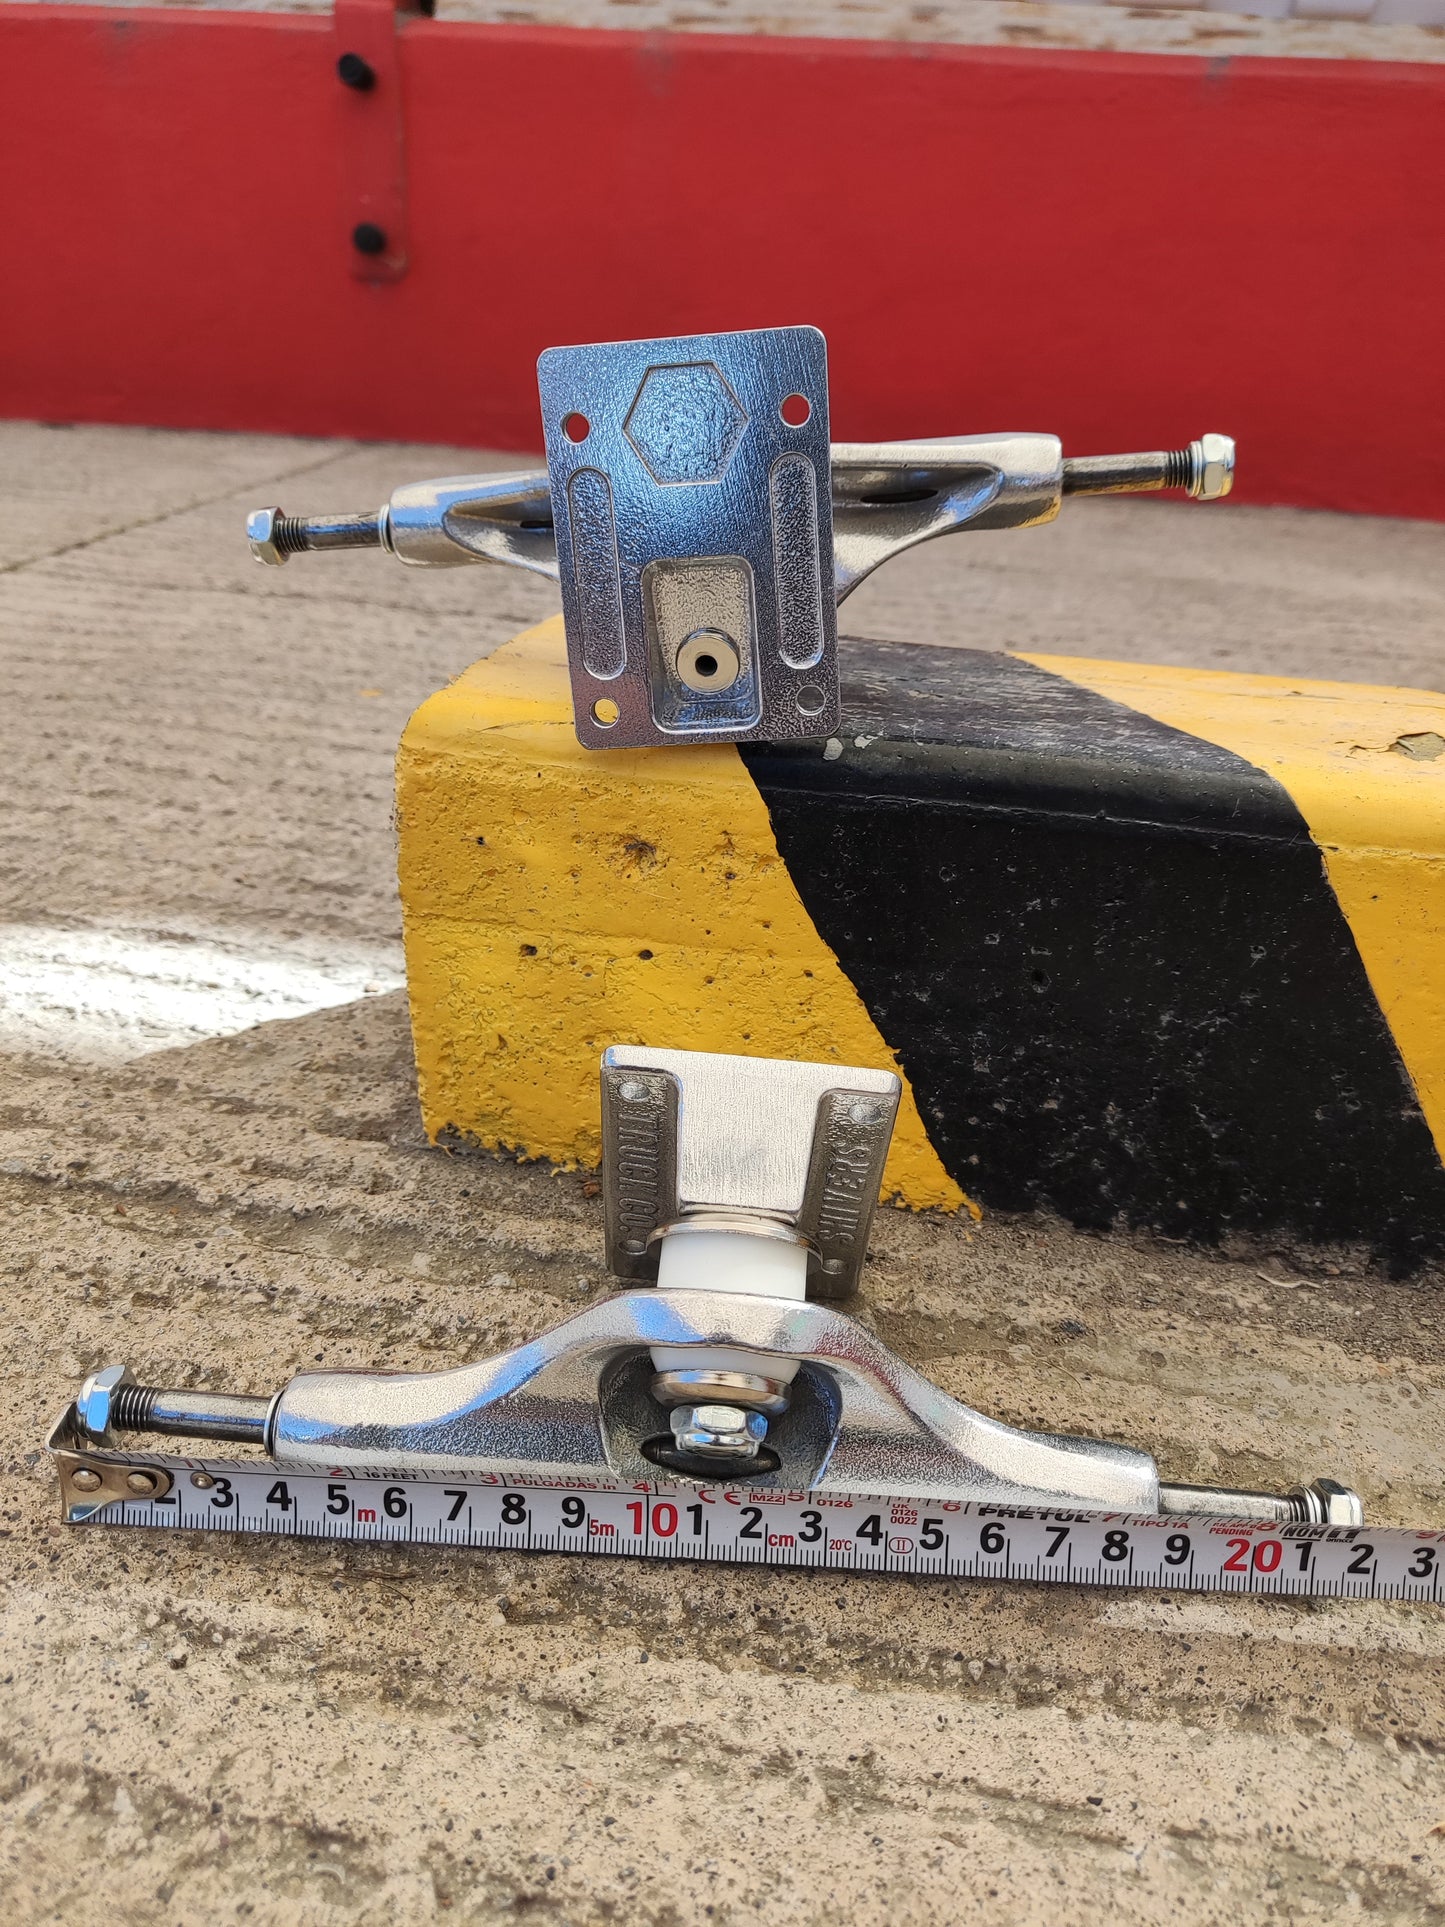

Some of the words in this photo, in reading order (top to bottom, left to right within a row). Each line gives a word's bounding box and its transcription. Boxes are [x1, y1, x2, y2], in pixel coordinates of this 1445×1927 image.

[363, 1471, 380, 1479] 16
[383, 1472, 419, 1480] FEET
[480, 1472, 499, 1484] 3
[512, 1478, 597, 1489] PULGADAS
[632, 1480, 651, 1492] 4
[752, 1494, 783, 1503] M22
[787, 1492, 805, 1502] 5
[816, 1499, 853, 1508] 0126
[942, 1502, 961, 1512] 6
[357, 1508, 376, 1523] m
[891, 1508, 918, 1517] 0126
[890, 1516, 918, 1525] 0022
[1102, 1513, 1120, 1523] 7
[210, 1477, 234, 1508] 3
[266, 1481, 293, 1511] 4
[326, 1484, 350, 1515] 5
[383, 1487, 407, 1518] 6
[443, 1490, 467, 1521] 7
[501, 1493, 526, 1525] 8
[561, 1496, 585, 1528] 9
[626, 1502, 679, 1537] 10
[686, 1503, 703, 1535] 1
[739, 1507, 763, 1539] 2
[798, 1510, 822, 1542] 3
[855, 1515, 883, 1546] 4
[919, 1518, 944, 1550] 5
[980, 1522, 1005, 1554] 6
[1045, 1526, 1070, 1558] 7
[1101, 1530, 1130, 1562] 8
[1164, 1534, 1191, 1565] 9
[1223, 1538, 1283, 1573] 20
[1295, 1541, 1313, 1571] 1
[1347, 1543, 1375, 1574] 2
[1408, 1547, 1436, 1578] 3
[589, 1519, 615, 1536] 5m
[1131, 1519, 1170, 1528] TIPO
[1171, 1521, 1189, 1529] 1A
[1256, 1522, 1278, 1531] 8
[1209, 1527, 1253, 1536] PENDING
[1283, 1526, 1324, 1539] NOM
[768, 1533, 794, 1548] cm
